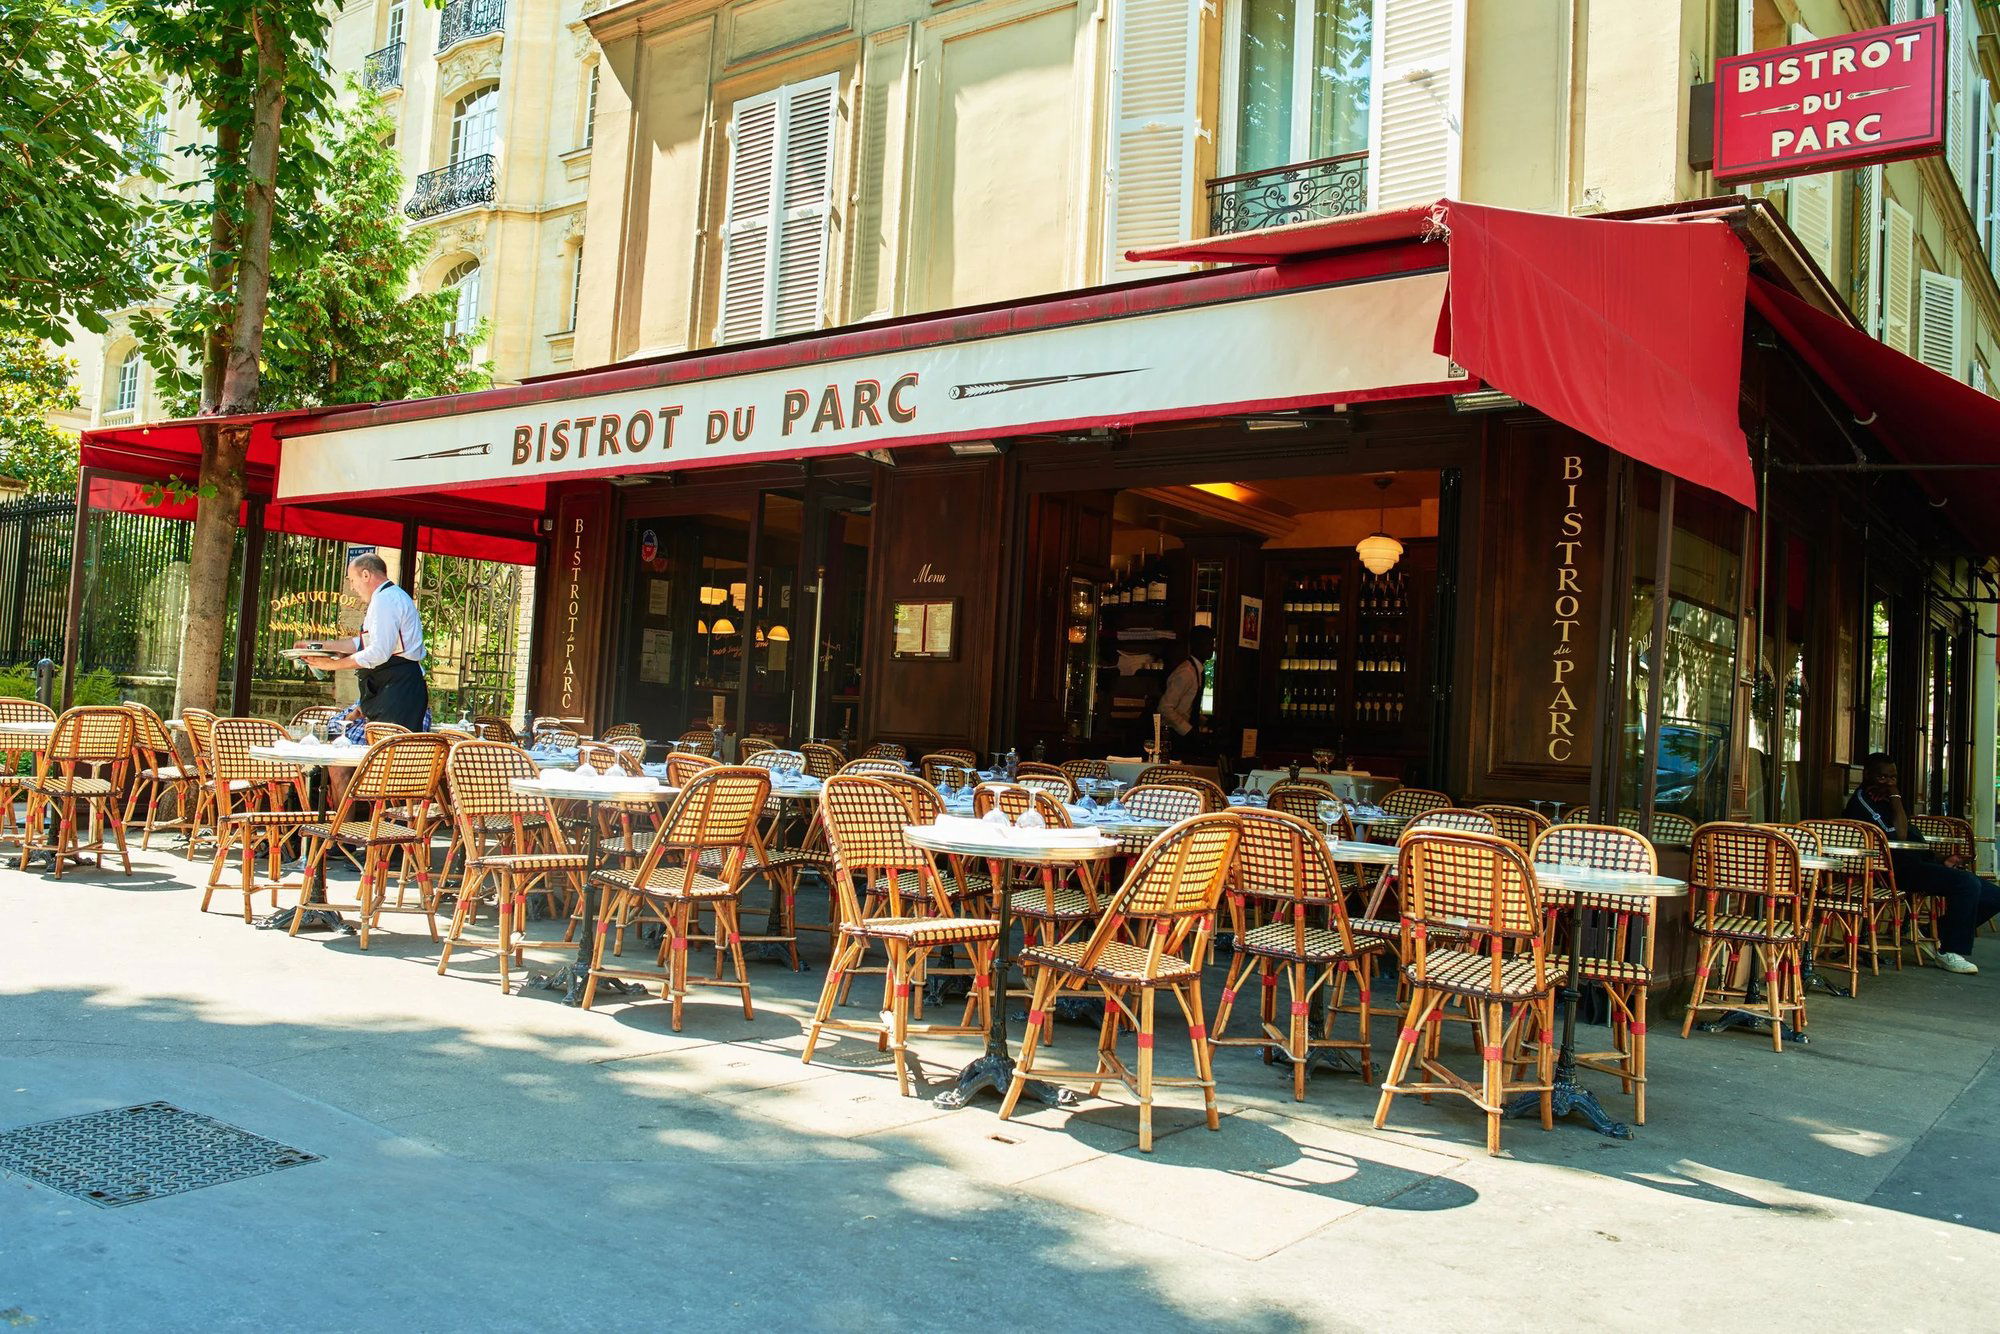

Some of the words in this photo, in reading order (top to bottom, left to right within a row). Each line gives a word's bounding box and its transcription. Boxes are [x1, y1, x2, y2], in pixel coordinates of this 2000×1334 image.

[1738, 32, 1922, 94] BISTROT
[1802, 89, 1843, 115] DU
[1771, 113, 1882, 157] PARC
[511, 404, 683, 466] BISTROT
[705, 405, 756, 445] DU
[781, 373, 919, 437] PARC
[567, 518, 584, 633] BISTROT
[912, 563, 947, 584] Menu
[1552, 455, 1584, 643] BISTROT
[561, 644, 575, 709] PARC
[1553, 644, 1572, 656] du
[1548, 659, 1578, 762] PARC
